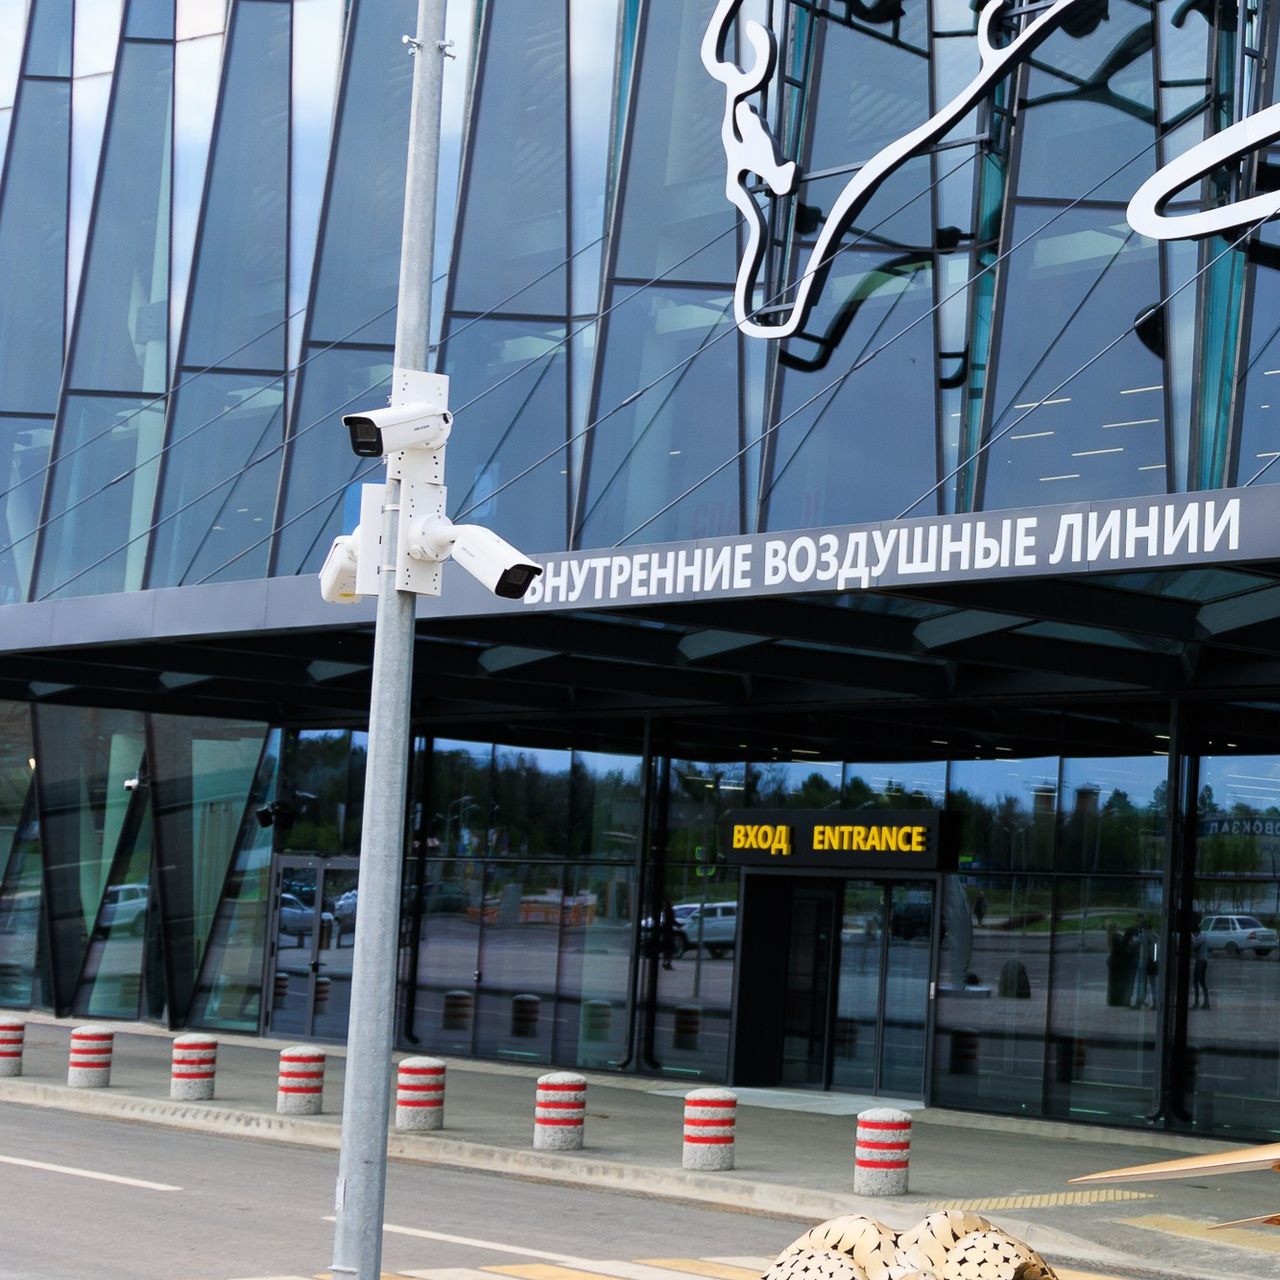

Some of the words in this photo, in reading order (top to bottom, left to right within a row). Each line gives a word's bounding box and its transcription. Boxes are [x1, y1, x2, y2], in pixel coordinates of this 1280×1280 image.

[764, 517, 1037, 590] ВОЗДУШНЫЕ
[1049, 498, 1240, 565] ЛИНИИ
[733, 825, 791, 855] ВХОД
[813, 826, 927, 852] ENTRANCE
